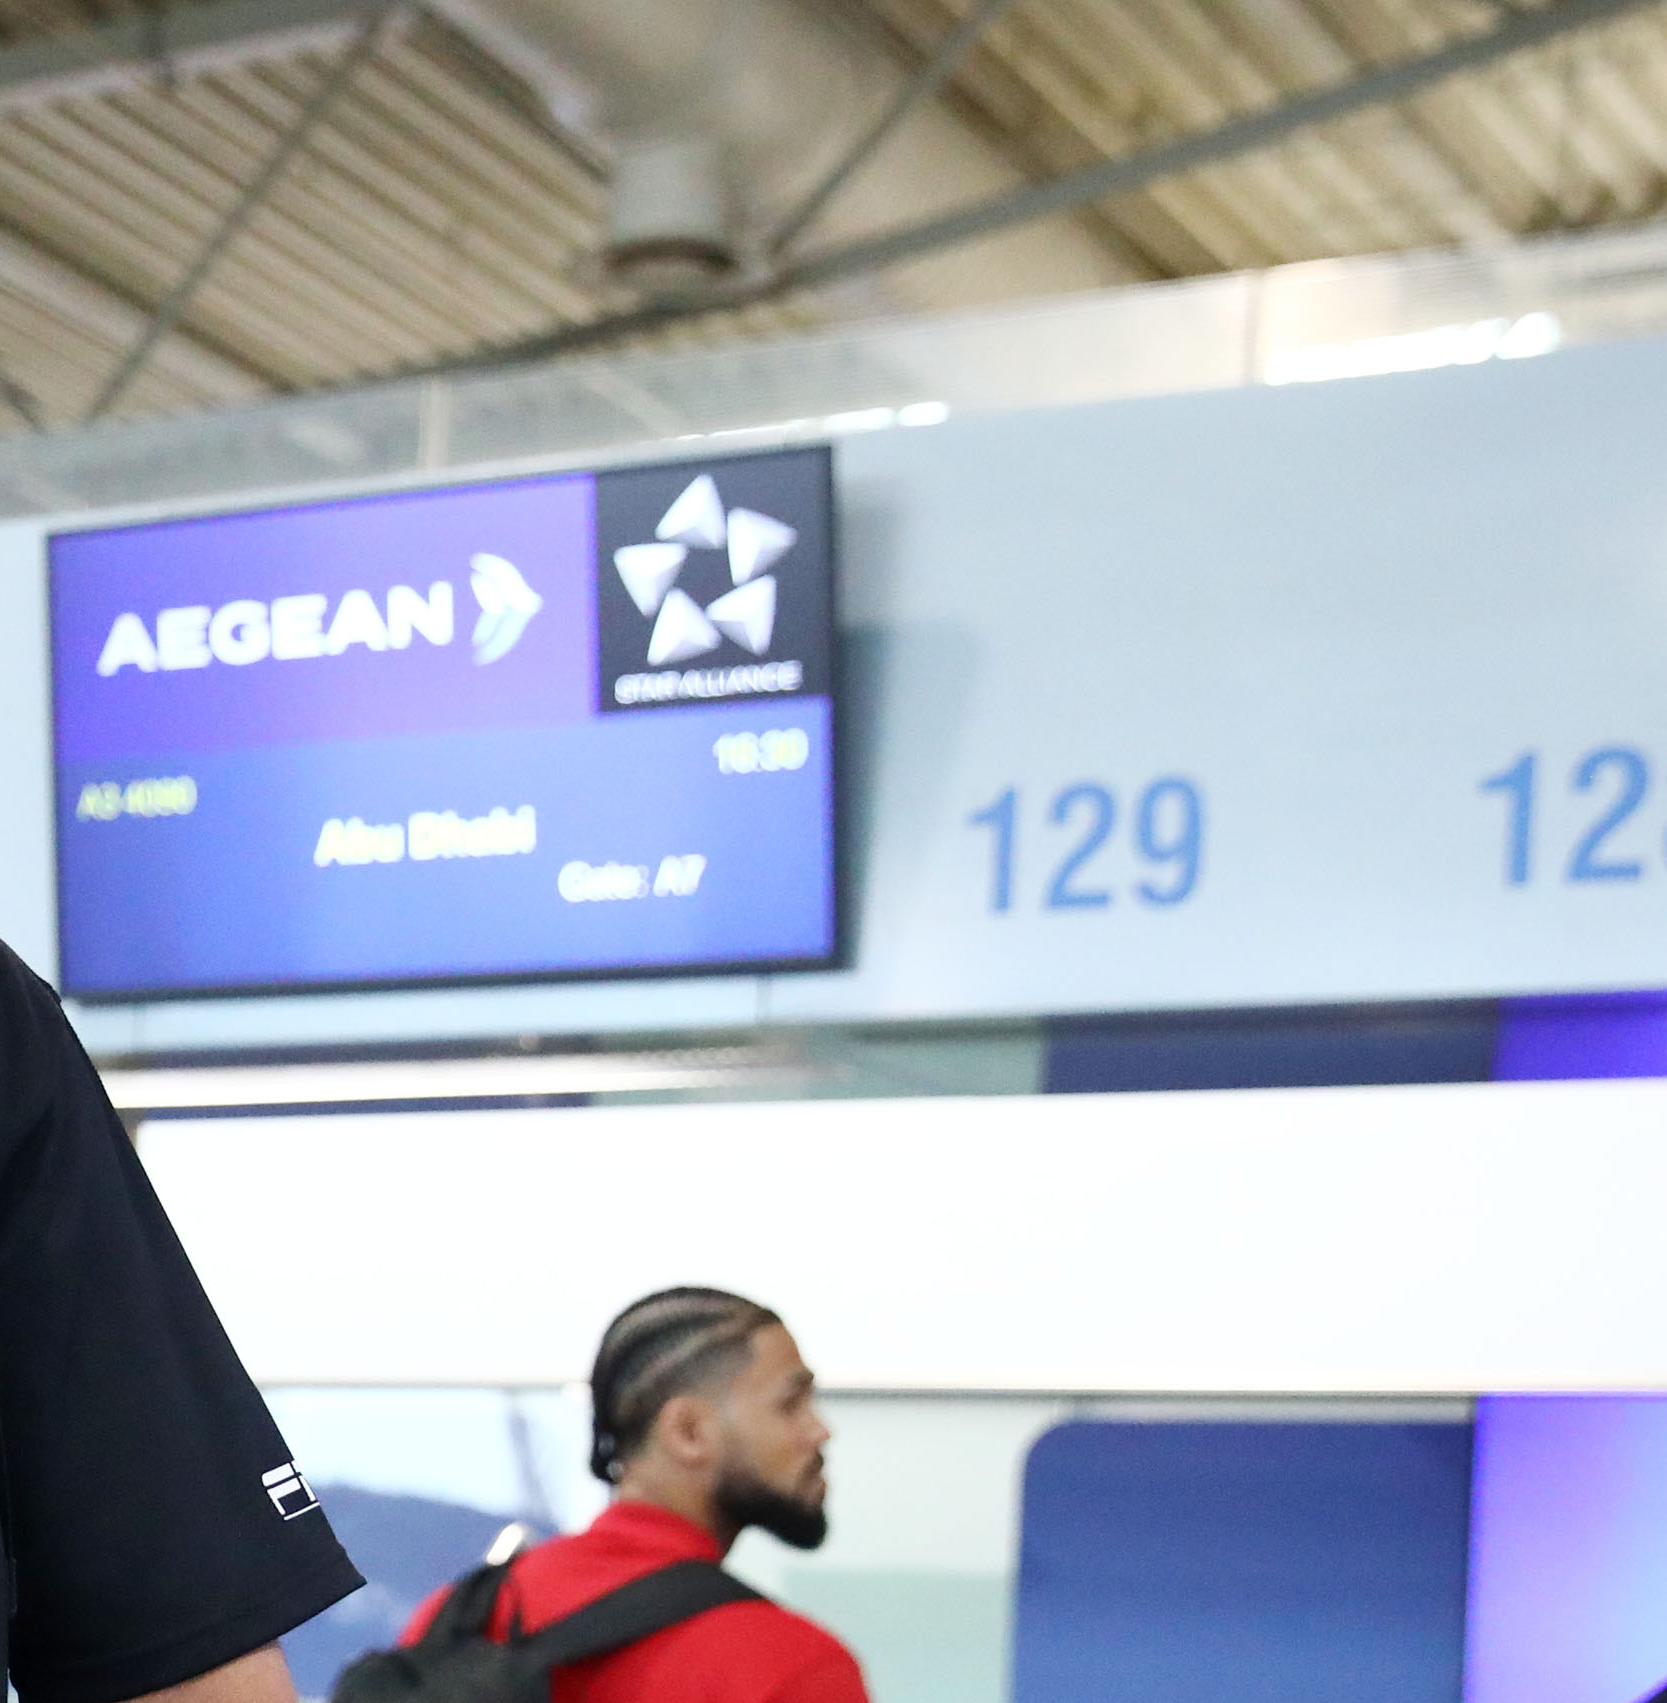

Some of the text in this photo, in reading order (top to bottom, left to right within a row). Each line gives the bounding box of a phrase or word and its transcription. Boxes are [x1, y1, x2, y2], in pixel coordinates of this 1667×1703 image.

[97, 580, 454, 676] AEGEAN
[680, 660, 803, 697] ALLIANCE
[314, 804, 537, 867] Abu Dhabi
[966, 774, 1208, 916] 129
[1476, 742, 1667, 889] 12
